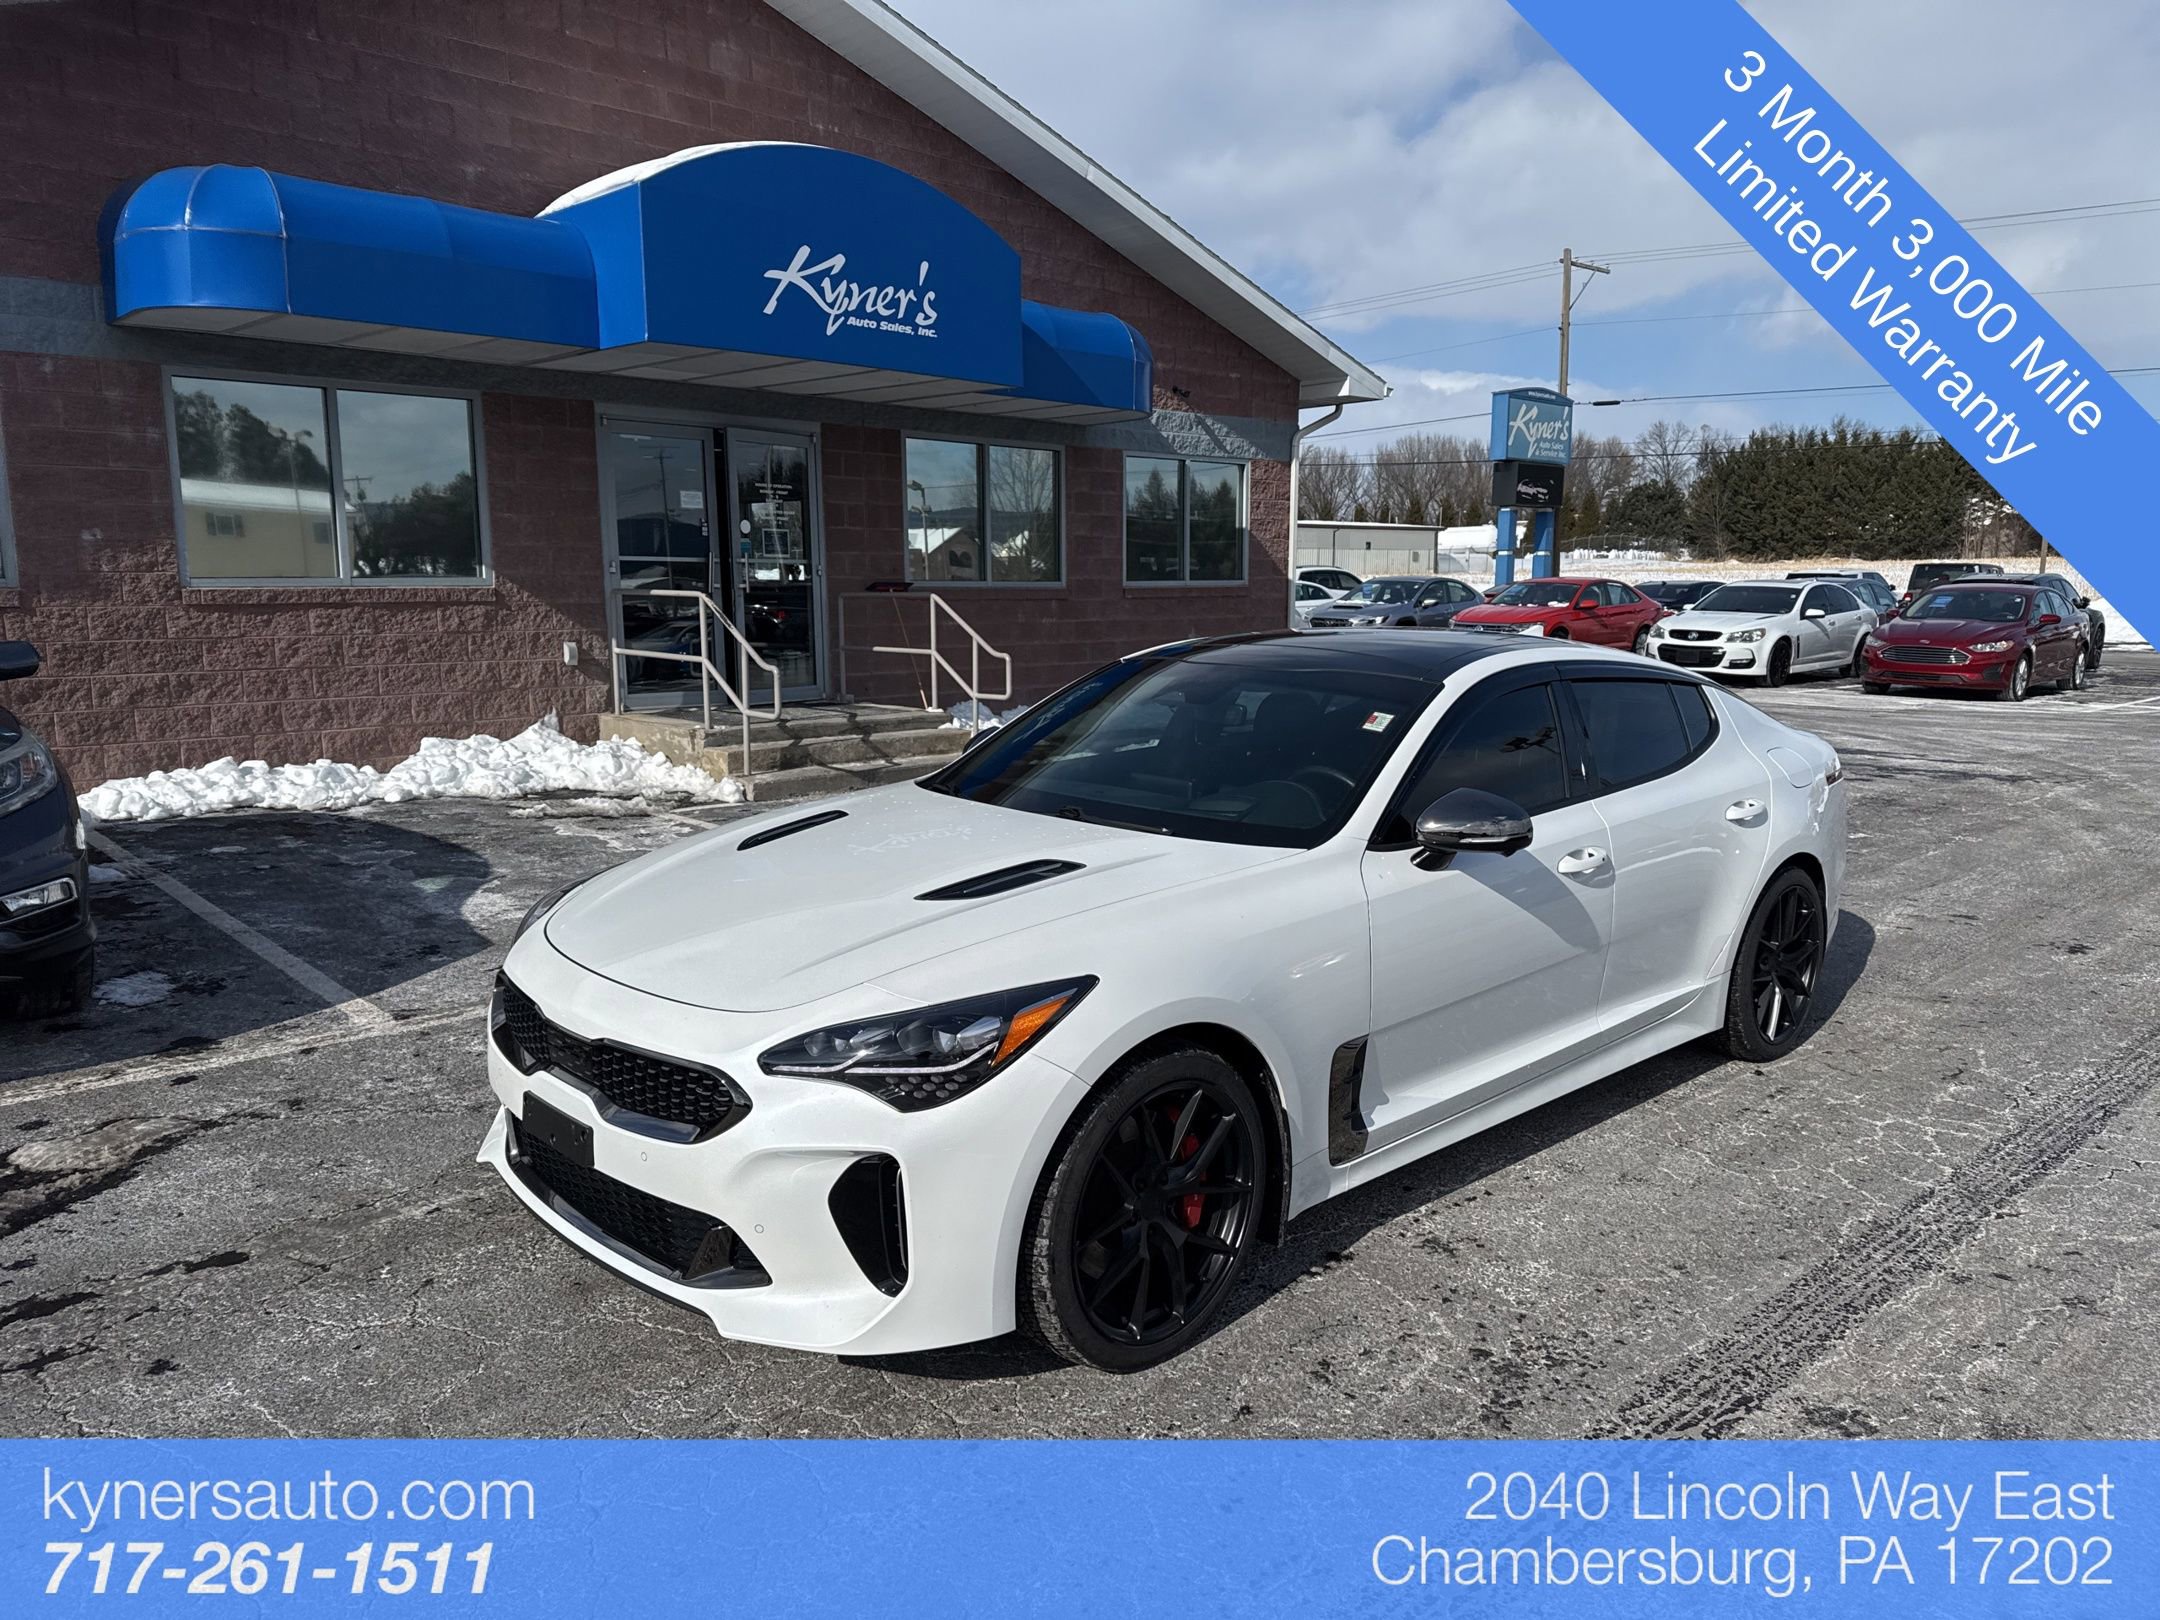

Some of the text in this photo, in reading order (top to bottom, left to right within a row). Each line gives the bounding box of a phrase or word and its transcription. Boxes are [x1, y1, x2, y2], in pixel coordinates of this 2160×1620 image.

[763, 244, 938, 336] Kyner's
[846, 316, 938, 338] Auto Sales, Inc.
[1508, 403, 1570, 459] Kyner's
